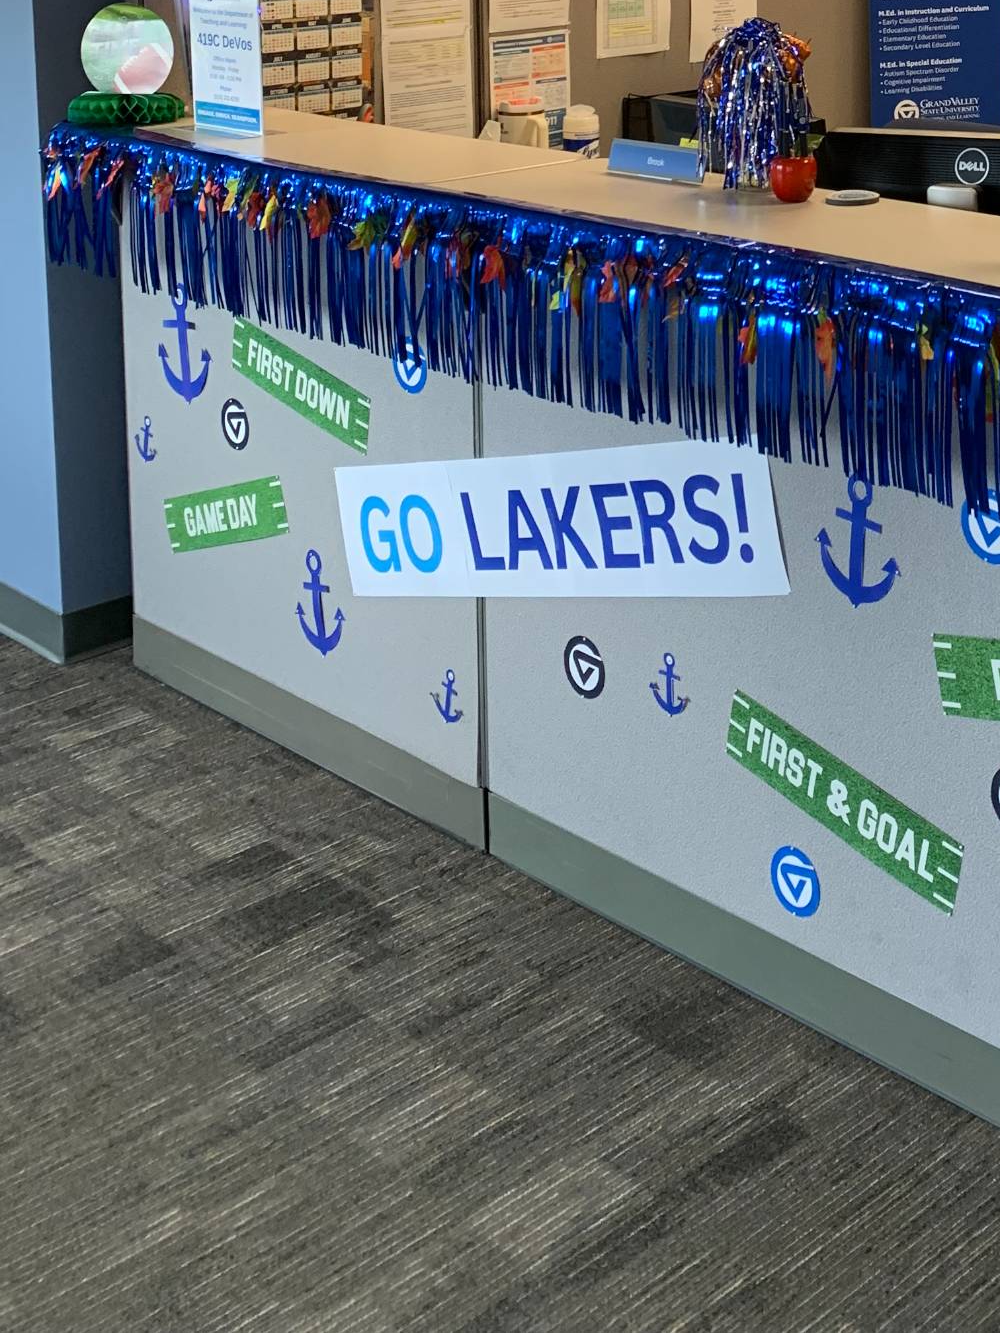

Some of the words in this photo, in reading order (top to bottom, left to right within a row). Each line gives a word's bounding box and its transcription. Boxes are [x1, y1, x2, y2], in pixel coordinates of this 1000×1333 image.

[905, 7, 940, 15] Instruction
[883, 26, 917, 34] Educational
[918, 24, 960, 32] Differentiation
[197, 32, 220, 47] 419C
[222, 35, 253, 51] DeVos
[883, 35, 916, 43] Elementary
[917, 33, 947, 41] Education
[883, 44, 914, 52] Secondary
[906, 59, 930, 67] Special
[931, 57, 963, 65] Education
[912, 76, 945, 84] Impairment
[884, 87, 910, 95] Learning
[920, 98, 951, 108] GRAND
[950, 97, 980, 106] VALLEY
[920, 108, 939, 116] STATE
[940, 105, 980, 114] UNIVERSITY
[958, 161, 986, 172] DELL
[247, 338, 294, 392] FIRST
[295, 368, 350, 430] DOWN
[184, 503, 227, 537] GAME
[227, 494, 258, 528] DAY
[360, 494, 443, 574] GO
[460, 473, 755, 571] LAKERS!
[746, 718, 823, 798] FIRST
[826, 778, 851, 827] &
[857, 800, 935, 884] GOAL
